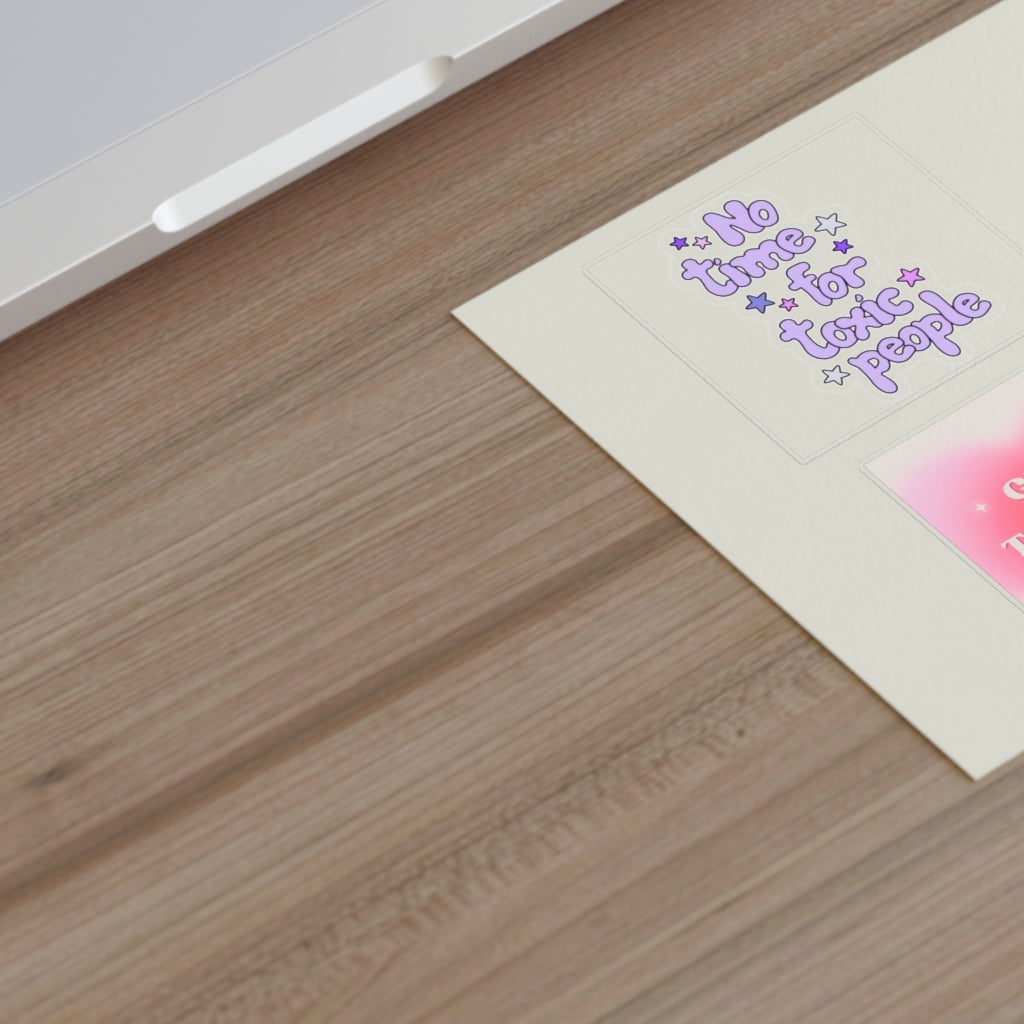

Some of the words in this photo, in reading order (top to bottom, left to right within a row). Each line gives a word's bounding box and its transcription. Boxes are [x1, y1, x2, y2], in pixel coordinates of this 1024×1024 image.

[702, 200, 779, 246] No
[681, 227, 816, 297] time
[786, 256, 867, 306] for
[779, 287, 914, 359] toxic
[847, 290, 992, 393] people
